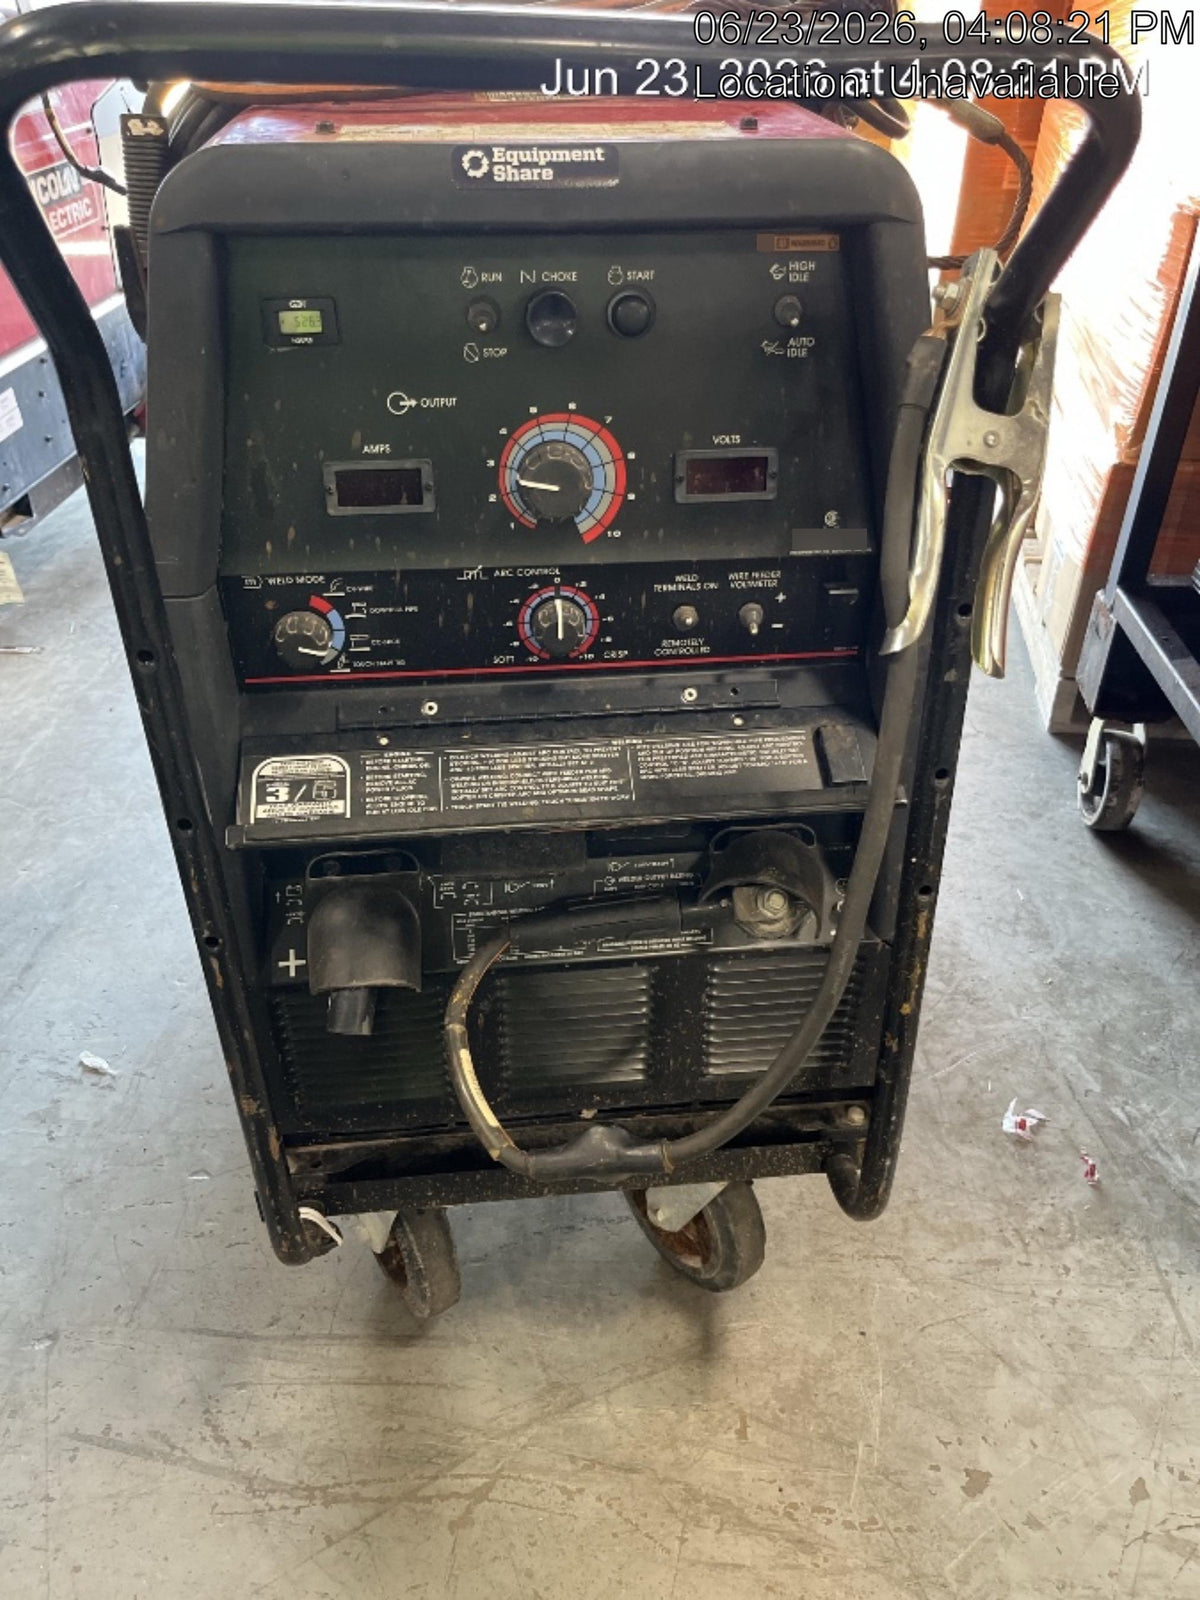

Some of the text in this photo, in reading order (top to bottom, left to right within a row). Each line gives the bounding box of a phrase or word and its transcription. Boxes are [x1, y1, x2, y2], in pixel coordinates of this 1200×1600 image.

[492, 147, 605, 165] Equipment
[493, 164, 553, 182] Share
[48, 198, 92, 231] ECTRIC
[788, 261, 816, 271] HIGH
[481, 272, 502, 282] RUN
[541, 271, 578, 282] CHOKE
[626, 270, 655, 281] START
[788, 272, 810, 282] IDLE
[787, 337, 815, 347] AUTO
[483, 348, 507, 358] STOP
[787, 348, 808, 358] IDLE
[420, 397, 457, 408] OUTPUT
[604, 415, 613, 424] 7
[712, 435, 741, 444] VOLTS
[362, 443, 391, 454] AMPS
[488, 493, 497, 503] 2
[607, 530, 622, 538] 10
[494, 568, 561, 577] ARC CONTROL
[267, 575, 326, 586] WELD MODE
